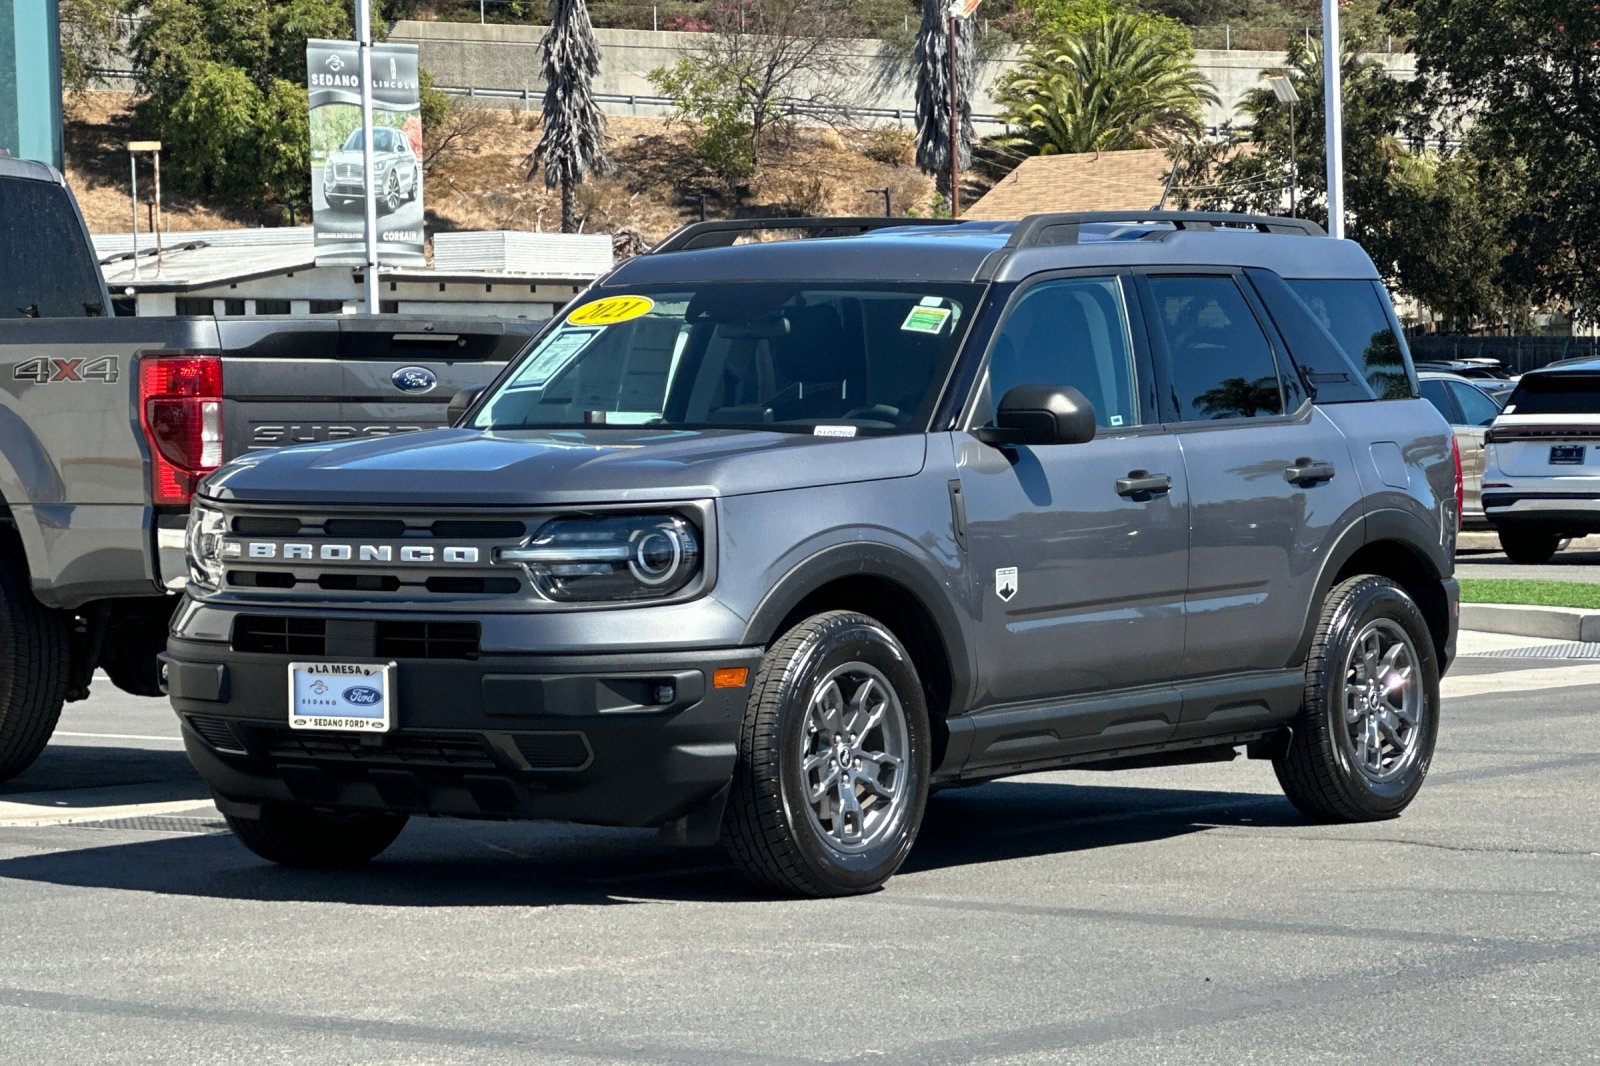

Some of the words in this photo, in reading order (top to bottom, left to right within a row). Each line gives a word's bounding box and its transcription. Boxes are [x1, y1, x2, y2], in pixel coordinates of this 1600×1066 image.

[311, 73, 359, 87] SEDANO
[372, 80, 417, 89] LINCOLN
[383, 231, 417, 242] CORSAIR
[574, 302, 643, 320] 2021
[249, 542, 479, 563] BRONCO
[315, 664, 329, 674] LA
[332, 665, 362, 675] MESA
[314, 719, 343, 727] SEDANO
[344, 719, 365, 728] FORD
